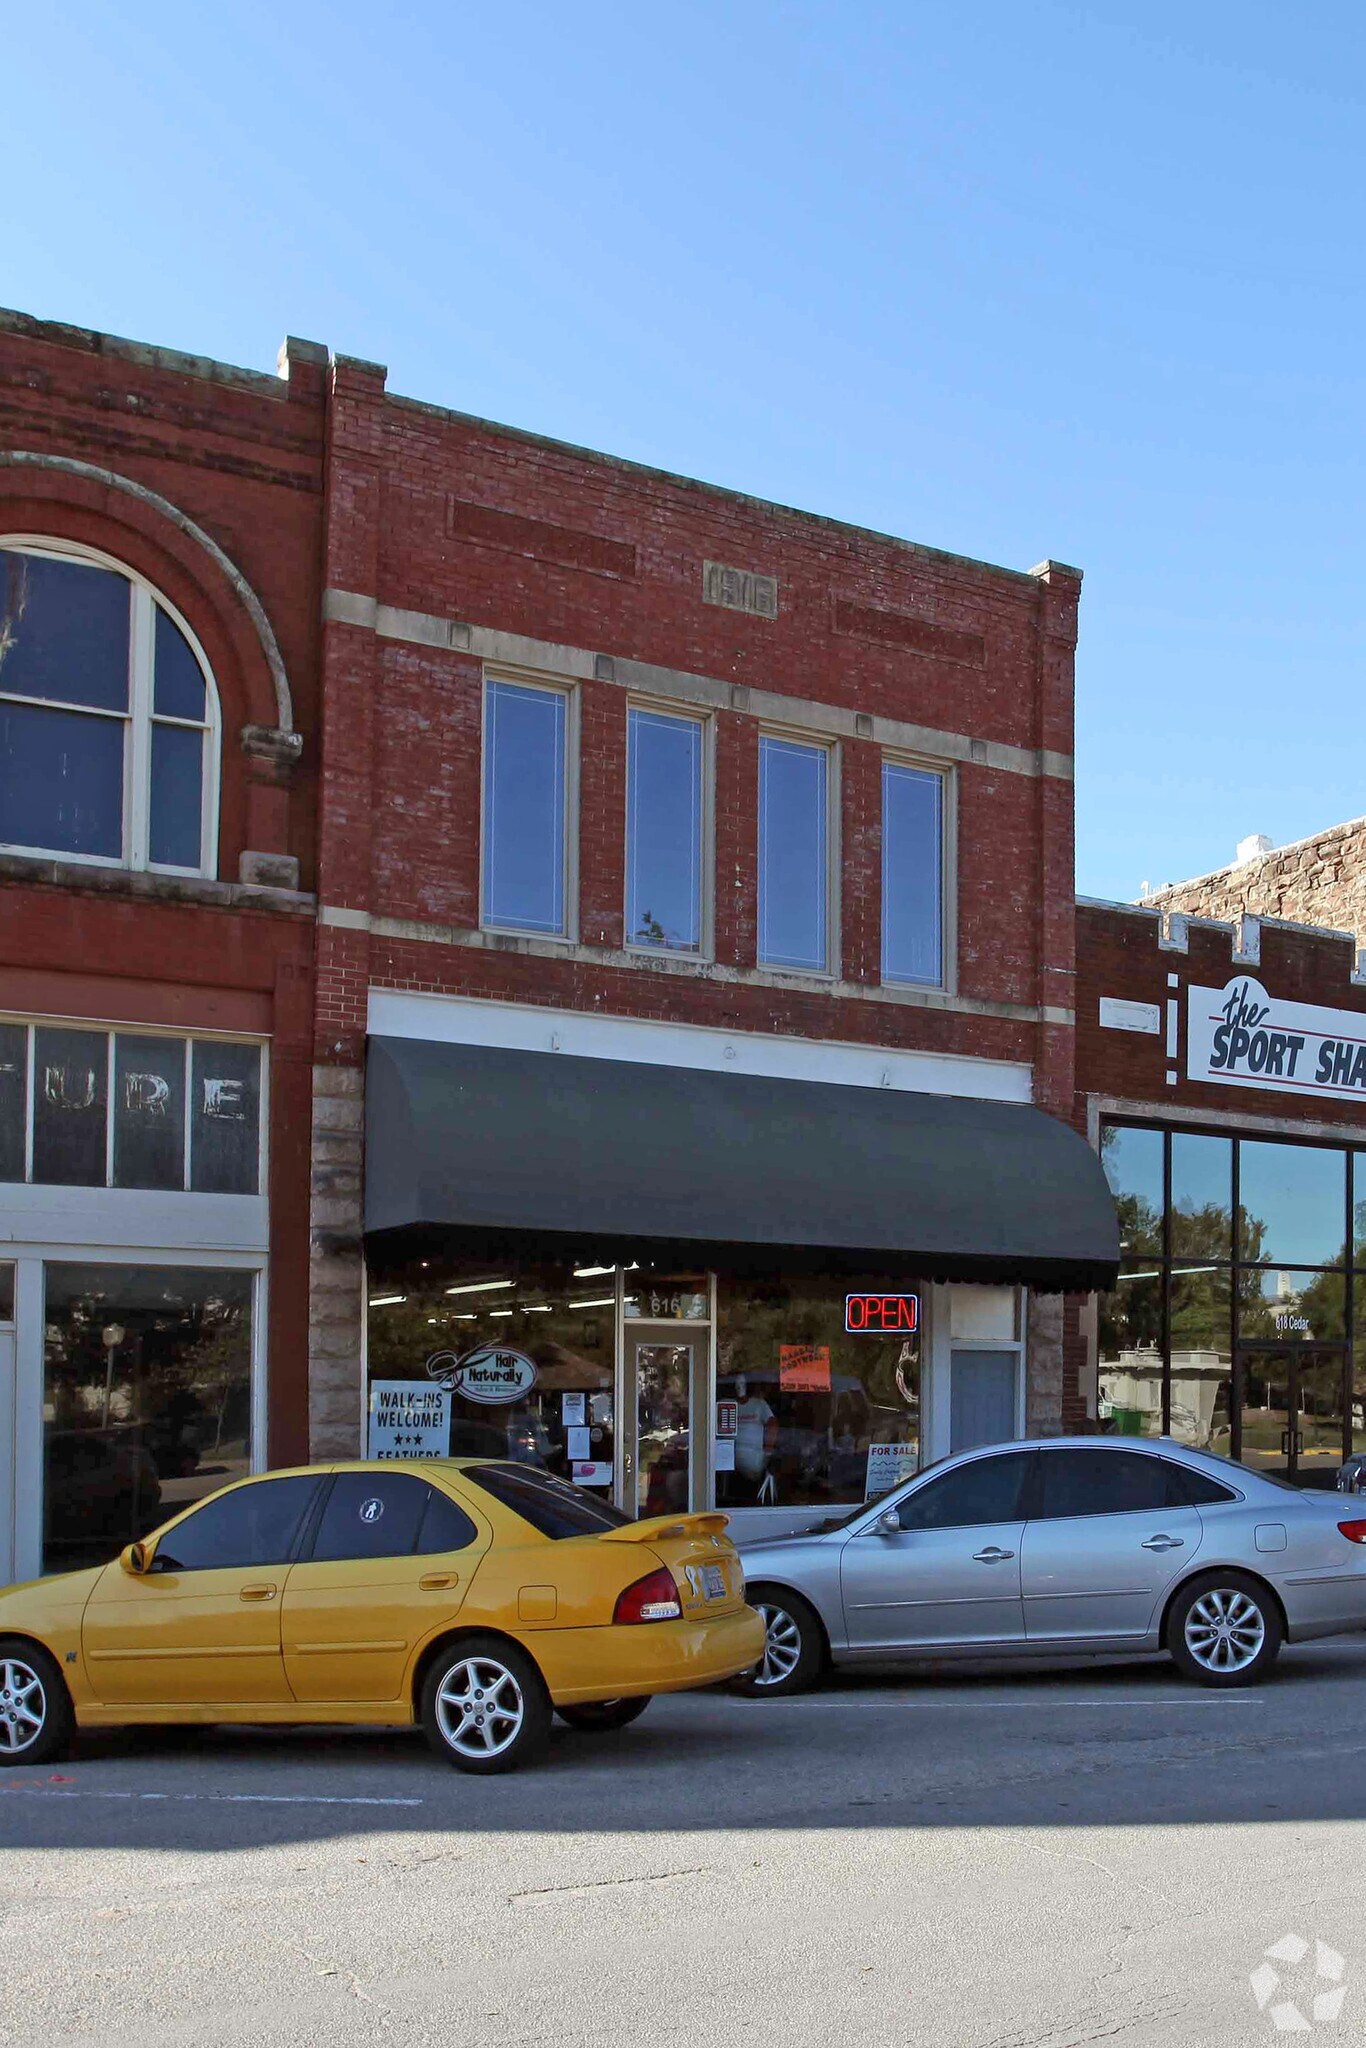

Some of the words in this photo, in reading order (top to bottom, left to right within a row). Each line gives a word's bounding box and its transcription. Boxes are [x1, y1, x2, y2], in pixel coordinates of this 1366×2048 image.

[1221, 980, 1270, 1028] the
[1209, 1024, 1305, 1078] SPORT
[651, 1297, 680, 1313] 616
[847, 1297, 916, 1329] OPEN
[1275, 1314, 1288, 1331] 618
[1289, 1314, 1310, 1331] Cedar
[495, 1354, 518, 1368] Hair
[468, 1368, 523, 1386] Naturally
[380, 1391, 443, 1409] WALK-INS
[377, 1411, 443, 1428] WELCOME!
[871, 1447, 890, 1456] FOR
[892, 1446, 917, 1456] SALE
